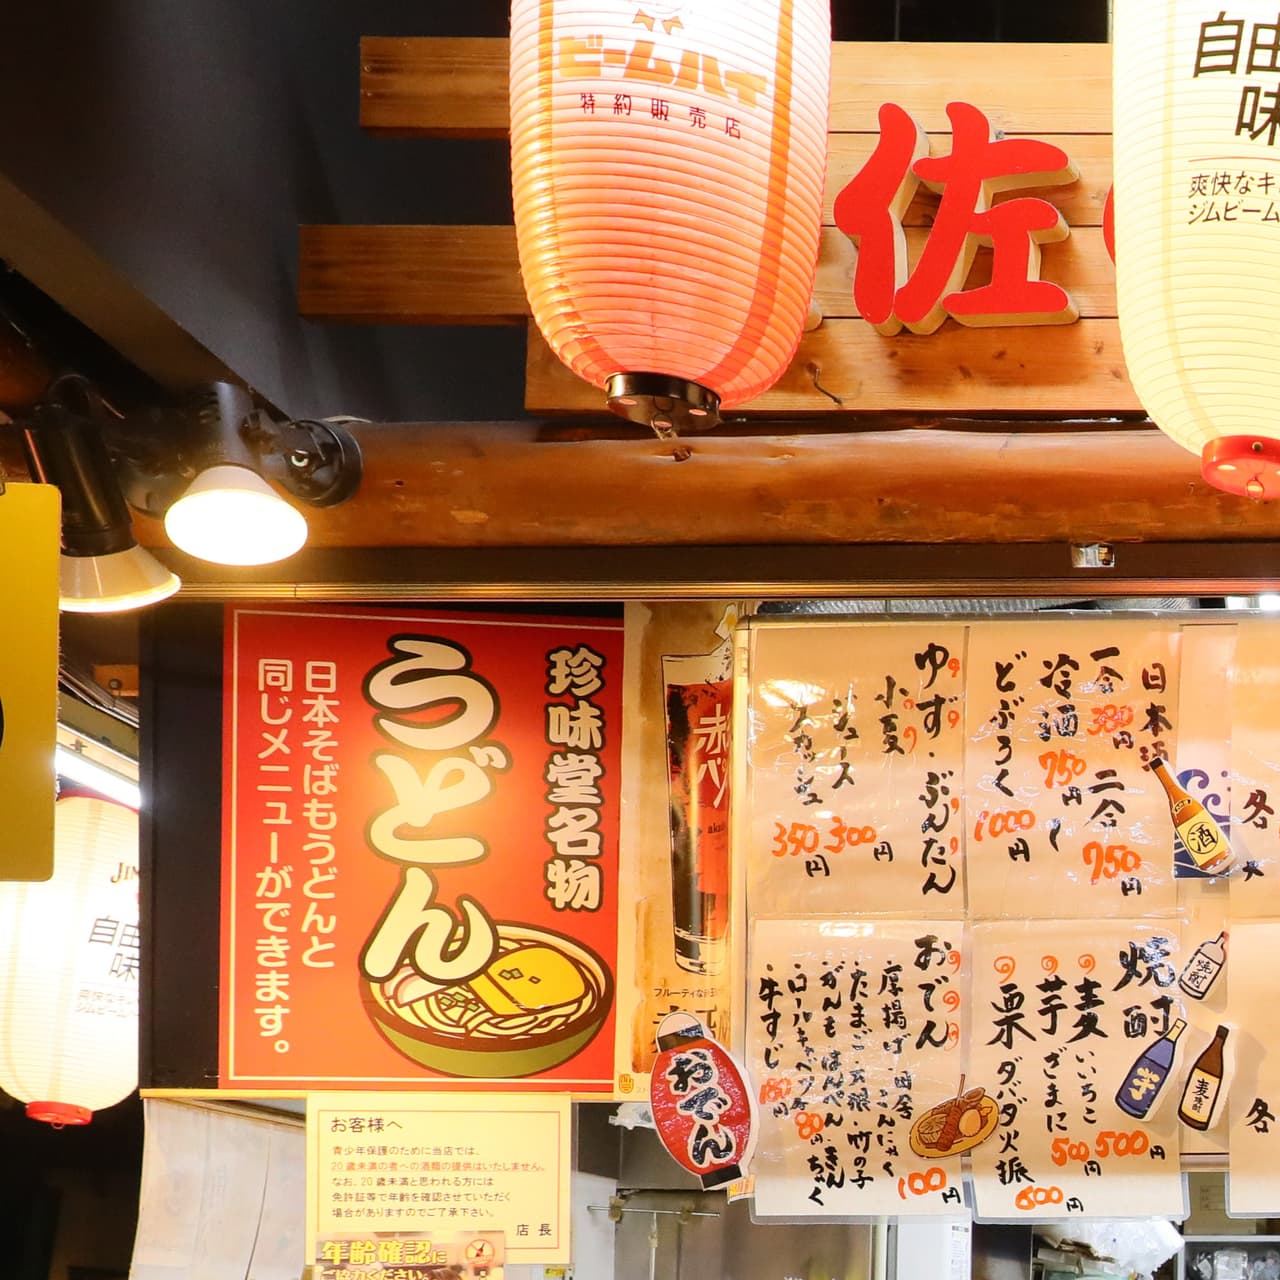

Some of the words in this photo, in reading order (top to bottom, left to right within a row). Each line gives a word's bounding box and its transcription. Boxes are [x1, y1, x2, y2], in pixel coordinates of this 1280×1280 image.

[580, 92, 741, 139] 特約販売店
[993, 651, 1028, 798] どぶろく
[1038, 653, 1080, 743] 冷酒
[301, 660, 340, 969] 日本そばもうどんと
[364, 637, 508, 981] うどん
[547, 647, 605, 911] 珍味堂名物
[1243, 789, 1275, 830] 各
[255, 658, 294, 1054] 同じメニューができます。
[1187, 824, 1217, 857] 酒
[914, 934, 952, 1050] おでん
[987, 982, 1037, 1047] 栗
[1035, 975, 1070, 1034] 芋
[1112, 936, 1177, 1041] 焼酎
[331, 1117, 403, 1133] お客様へ
[669, 1051, 732, 1168] おでん
[1075, 1049, 1098, 1124] いいちこ
[1129, 1066, 1160, 1102] 芋
[321, 1240, 447, 1266] 年齢確認に
